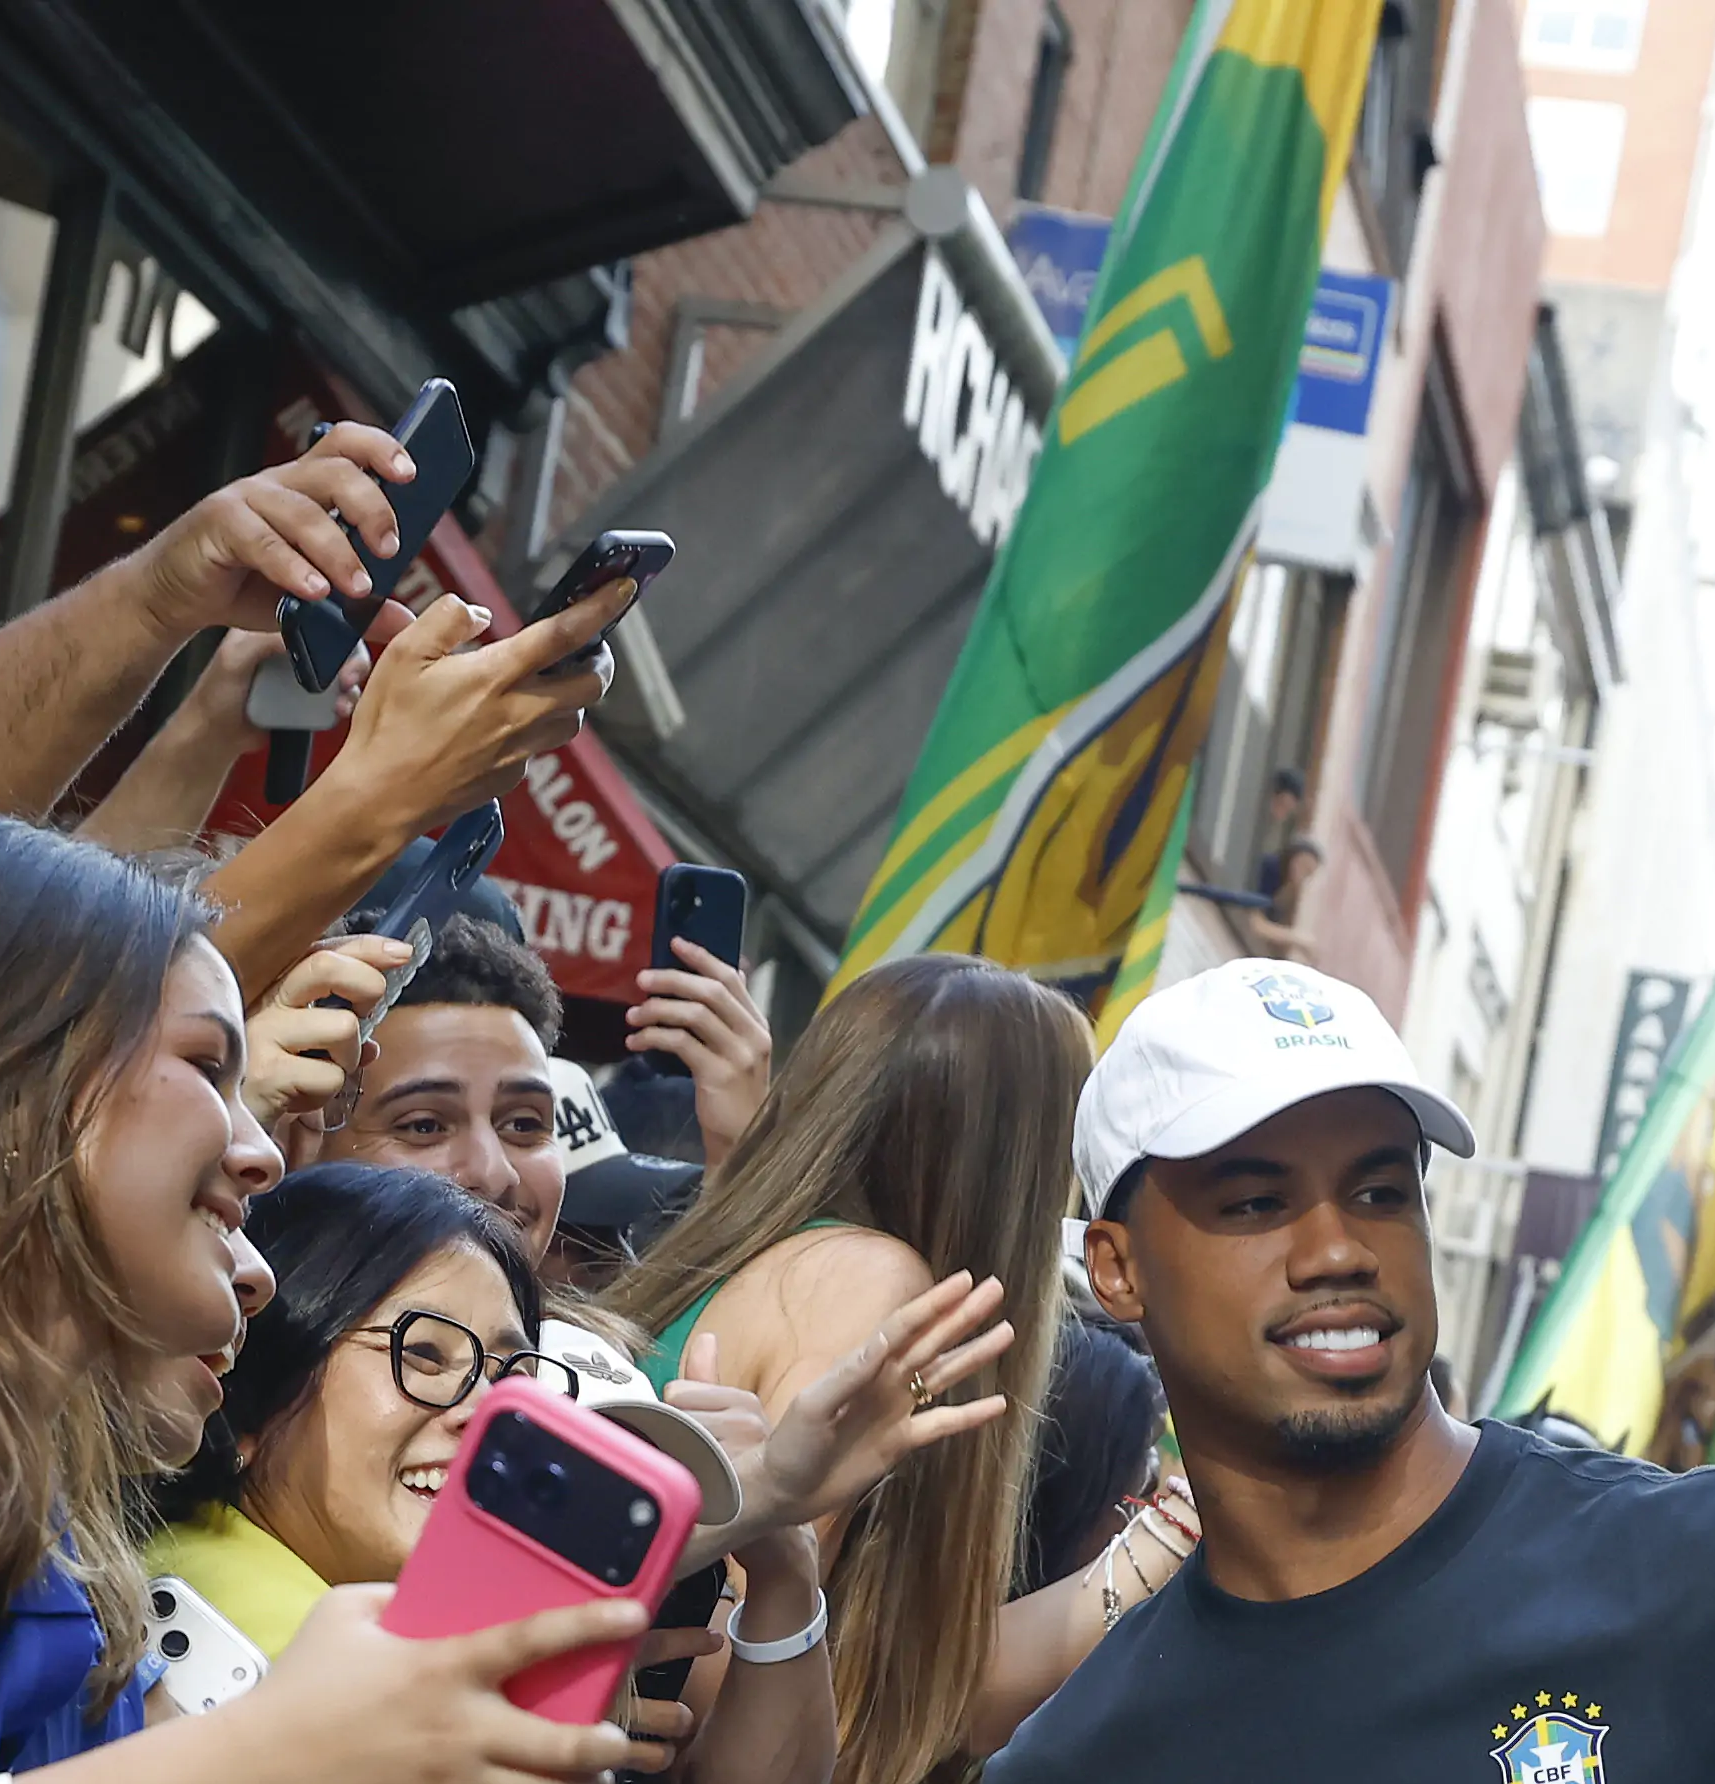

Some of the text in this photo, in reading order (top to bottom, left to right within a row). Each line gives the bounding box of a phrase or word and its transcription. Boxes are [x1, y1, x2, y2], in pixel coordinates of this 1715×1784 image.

[528, 751, 619, 873] ALON
[1274, 1034, 1354, 1050] BRASIL
[556, 1097, 602, 1151] LA
[1533, 1764, 1572, 1784] CBF
